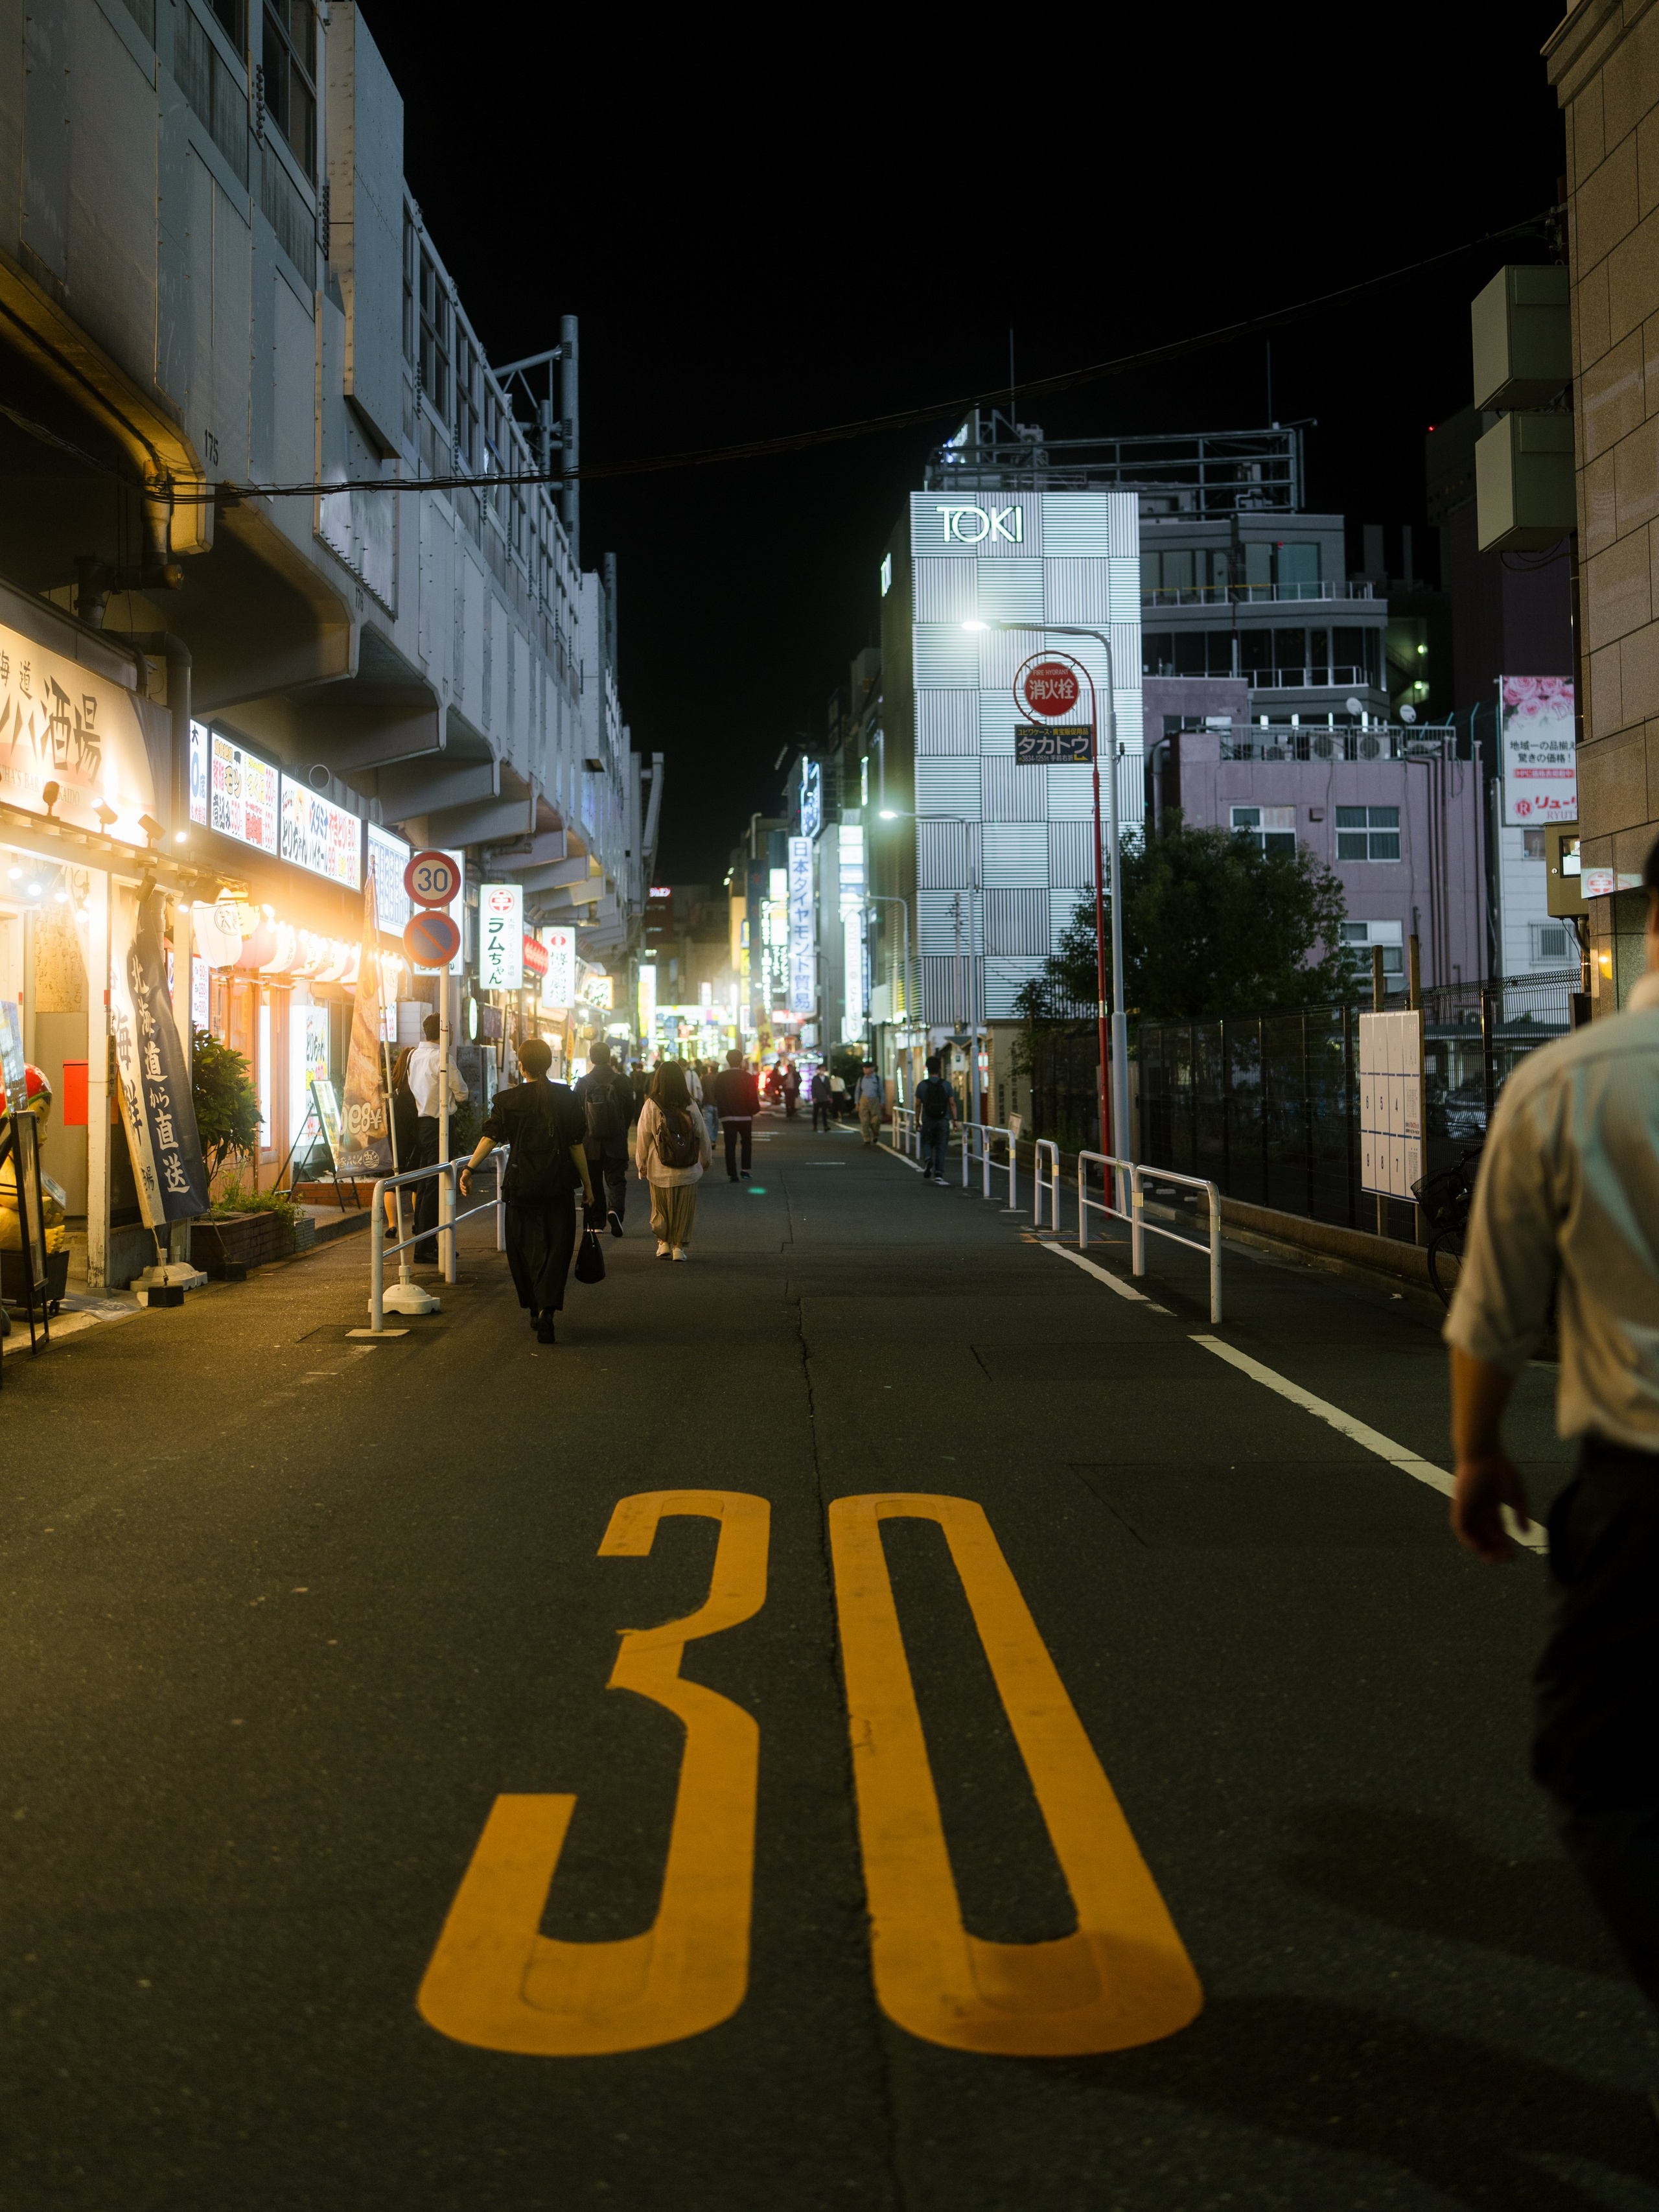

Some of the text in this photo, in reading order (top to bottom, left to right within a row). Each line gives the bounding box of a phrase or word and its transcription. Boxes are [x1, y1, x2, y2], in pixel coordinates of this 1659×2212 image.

[203, 428, 220, 467] 175
[936, 506, 1023, 542] TOKI
[354, 587, 364, 613] 176
[1030, 678, 1074, 700] 消火栓
[1017, 736, 1089, 754] タカトウ
[25, 772, 40, 793] BAR
[224, 765, 242, 799] モツ
[213, 792, 231, 830] 煮込み
[282, 816, 308, 865] とりちゃん
[417, 867, 448, 892] 30
[793, 841, 811, 1009] 日本ダイヤモンド貿易
[487, 918, 505, 984] ラムちゃん
[131, 954, 191, 1194] 北海道から直送
[1365, 1095, 1369, 1110] 6
[1380, 1096, 1384, 1110] 5
[1395, 1098, 1398, 1112] 4
[1366, 1153, 1399, 1172] 9 8 7
[417, 1489, 1204, 2057] 30
